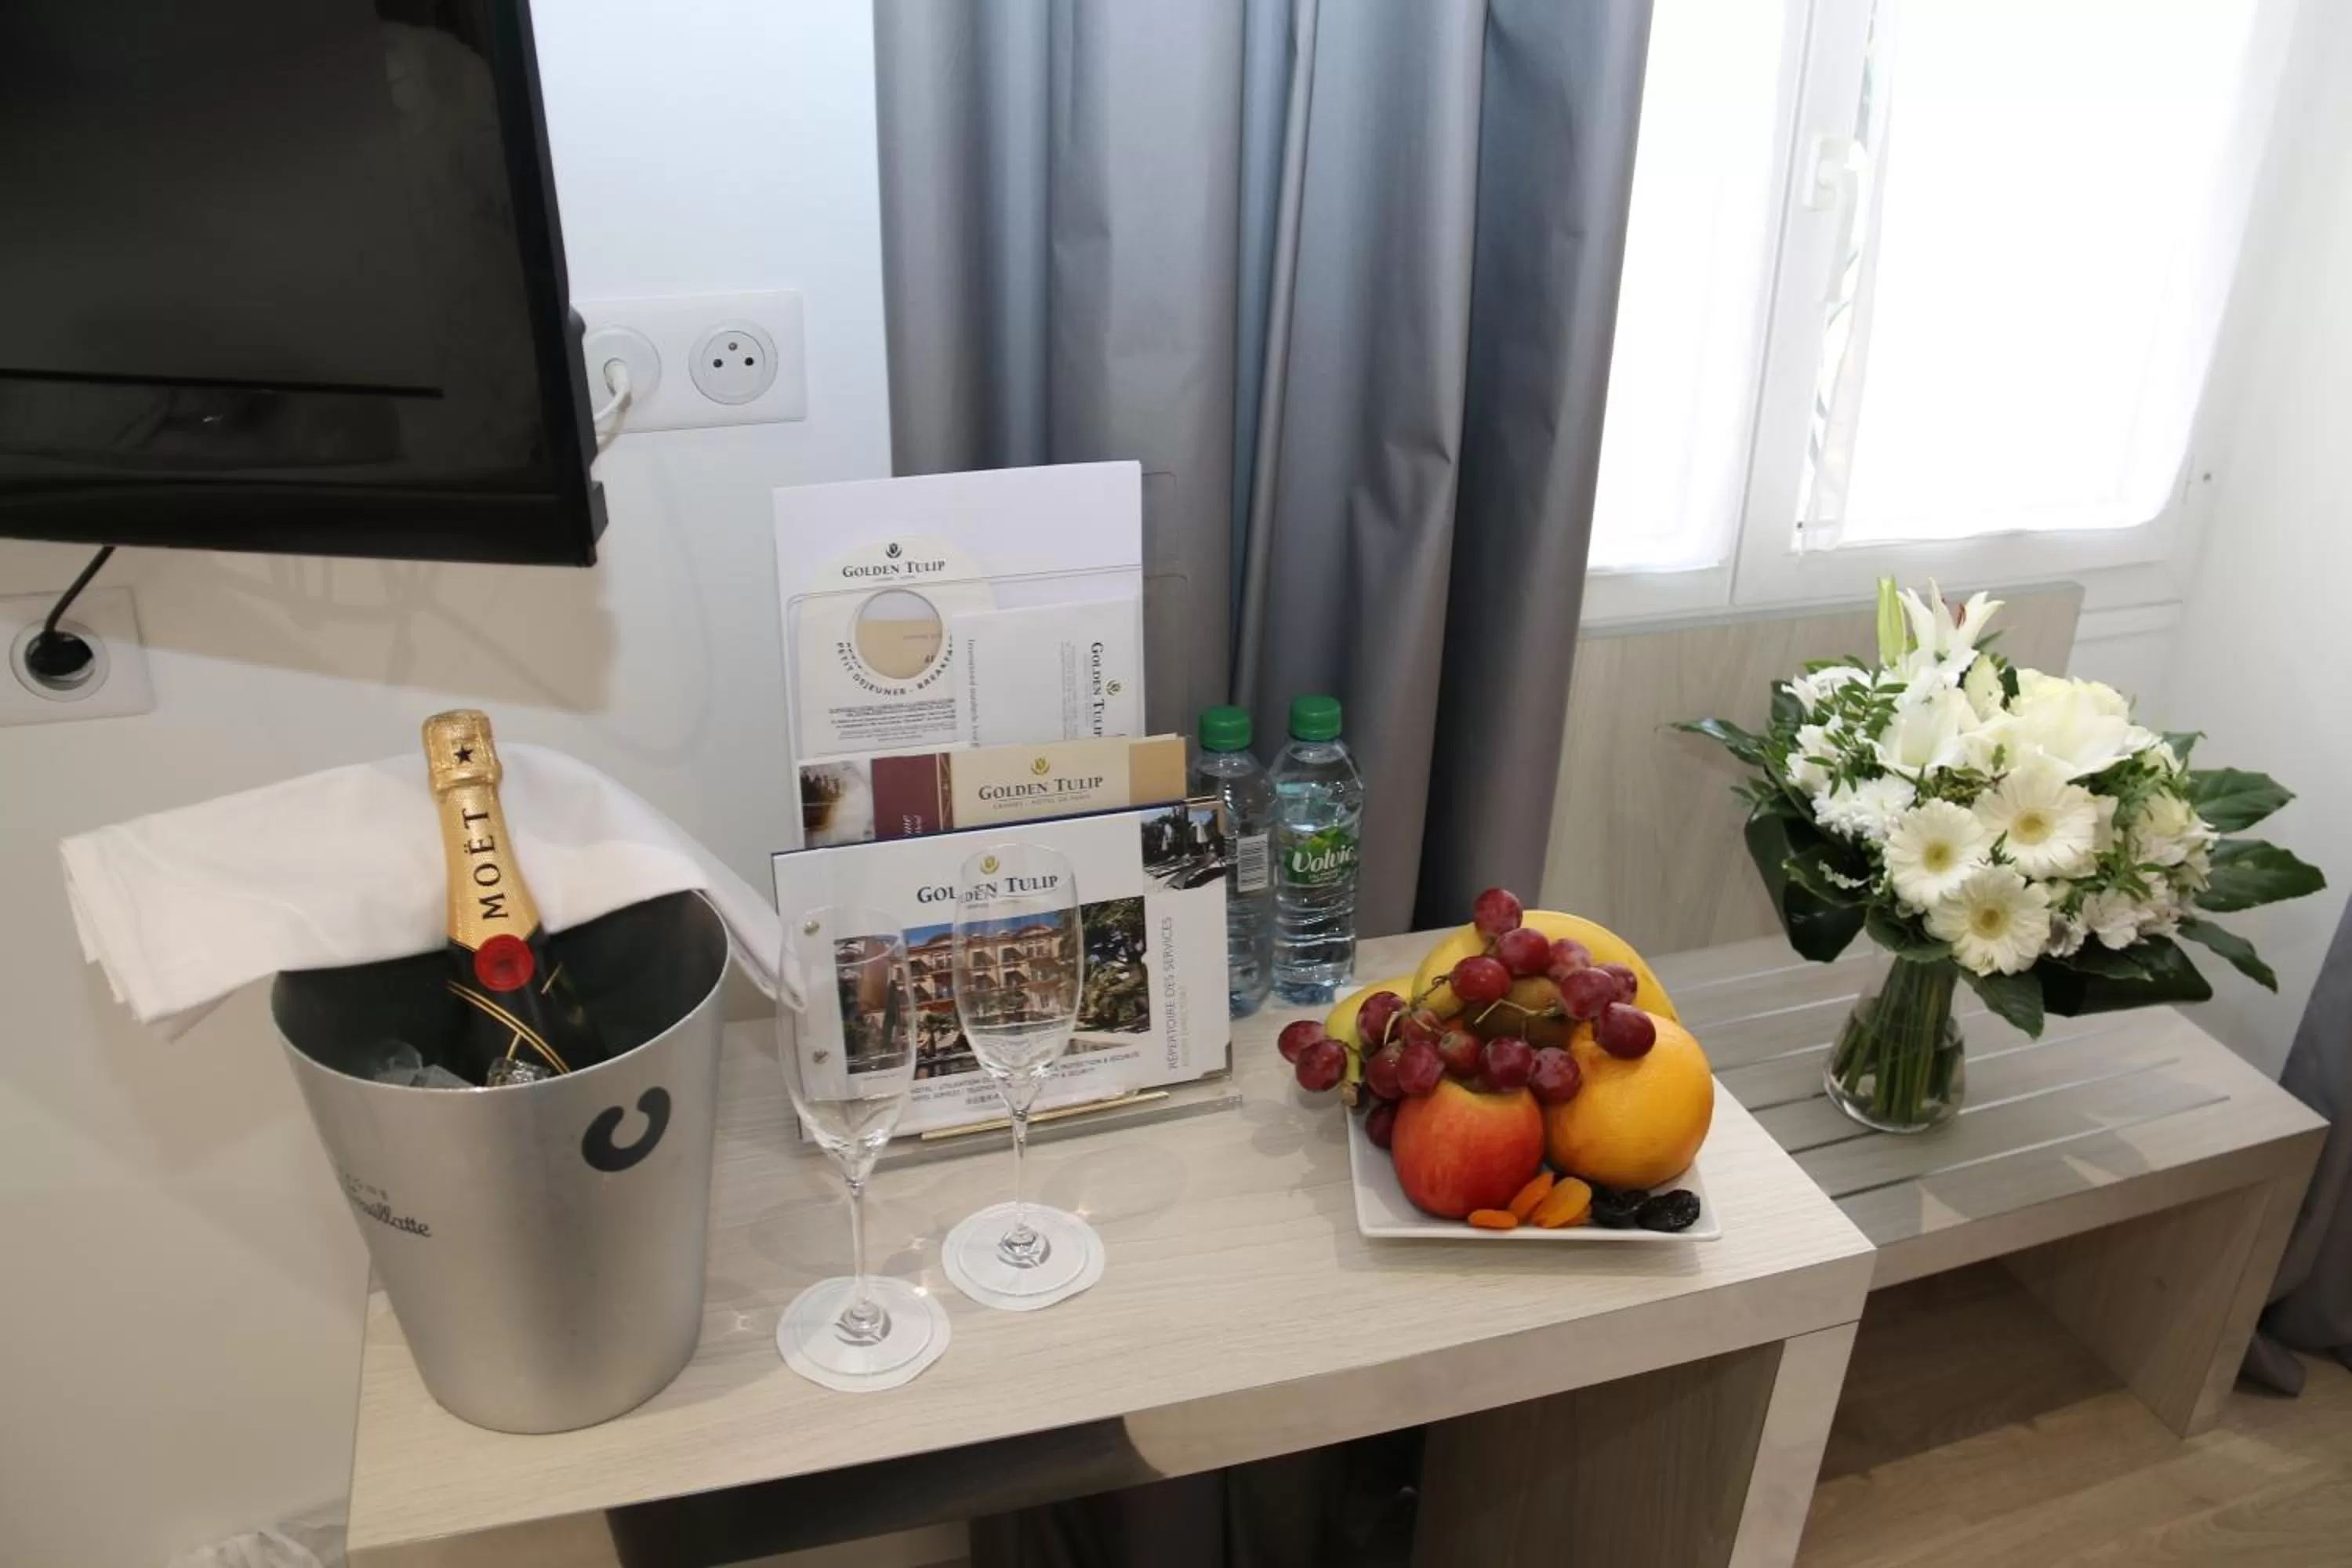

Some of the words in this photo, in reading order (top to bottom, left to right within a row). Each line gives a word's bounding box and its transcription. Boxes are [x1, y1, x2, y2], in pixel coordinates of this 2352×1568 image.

[842, 564, 900, 578] GOLDEN
[906, 559, 946, 574] TULIP
[836, 641, 855, 672] PETIT
[1091, 641, 1104, 695] GOLDEN
[978, 782, 1048, 800] GOLDEN
[1053, 776, 1103, 793] TULIP
[461, 808, 510, 920] MOËT
[1291, 844, 1358, 873] Volvic
[1005, 875, 1058, 893] TULIP
[1161, 916, 1174, 971] SERVICES
[1163, 973, 1176, 997] DES
